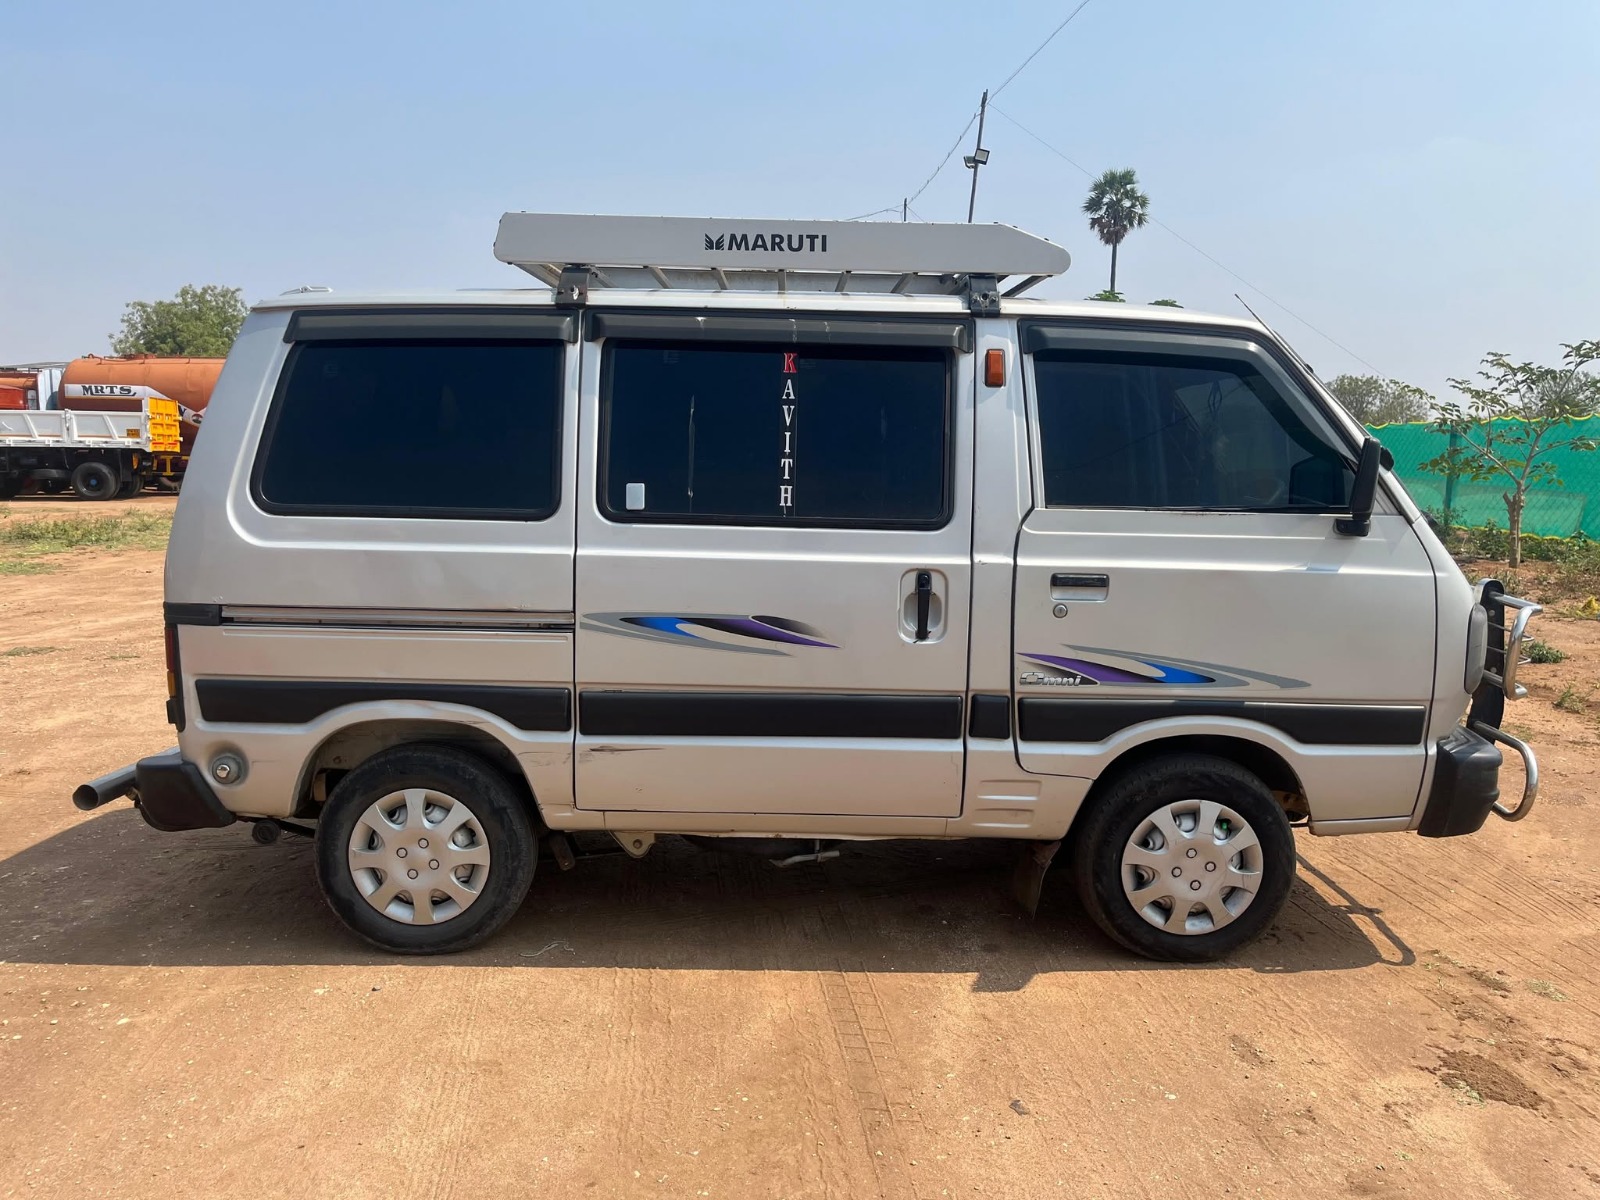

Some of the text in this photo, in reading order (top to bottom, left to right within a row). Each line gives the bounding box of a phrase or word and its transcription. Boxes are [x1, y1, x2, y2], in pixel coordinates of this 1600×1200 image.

[727, 233, 827, 252] MARUTI
[81, 385, 133, 396] MRTS
[1020, 672, 1081, 686] Omni
